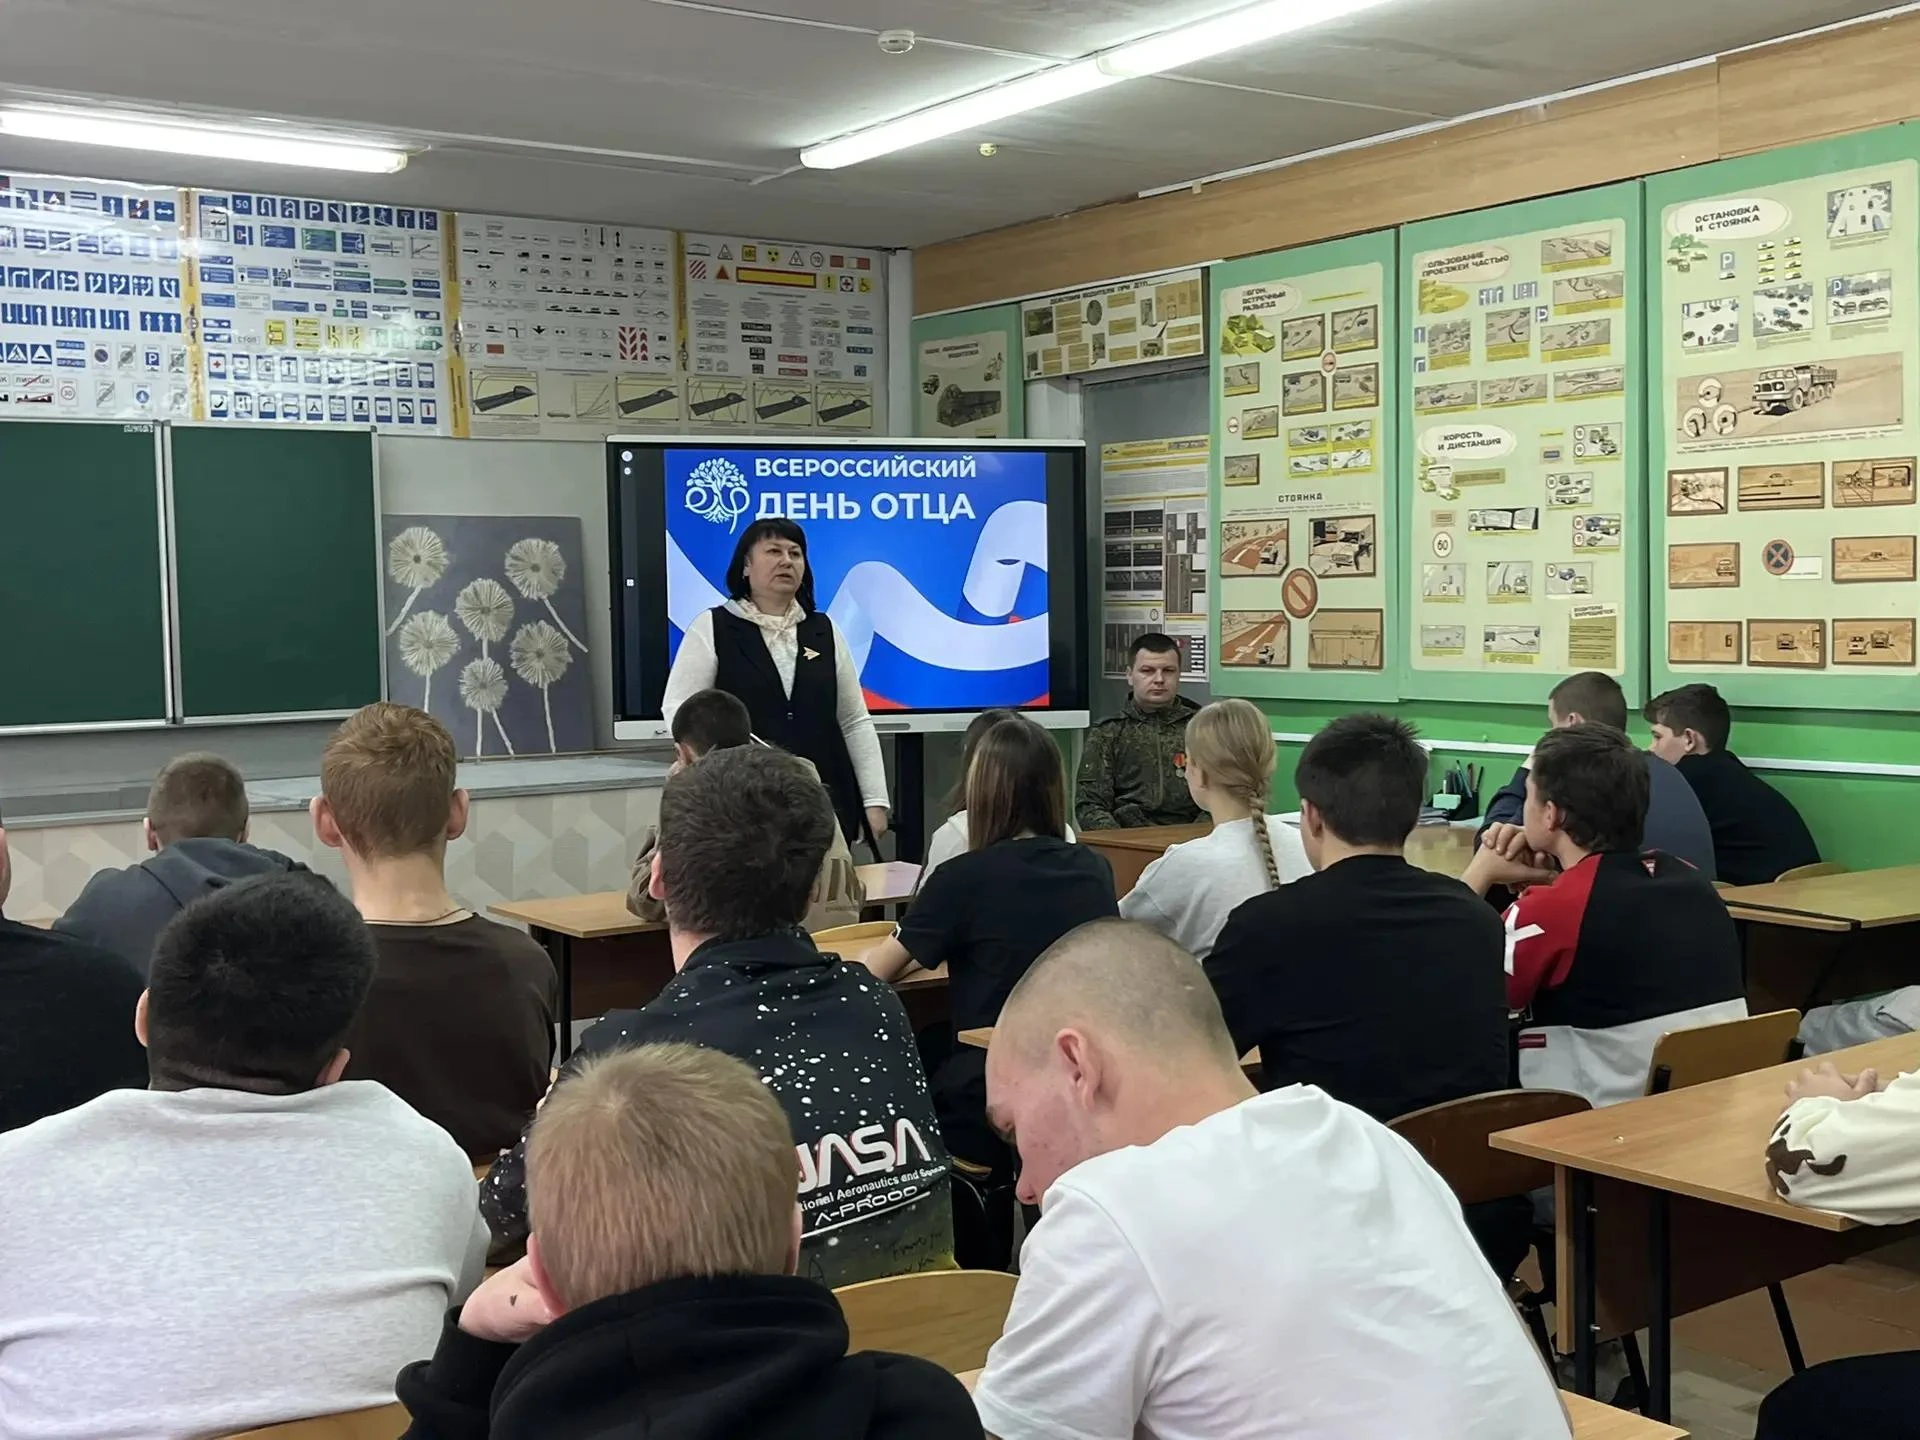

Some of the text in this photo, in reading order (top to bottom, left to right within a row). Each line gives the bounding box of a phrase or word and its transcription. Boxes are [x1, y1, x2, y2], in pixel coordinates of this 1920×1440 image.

[236, 200, 249, 209] 50
[309, 203, 320, 218] P
[1695, 205, 1760, 223] ОСТАНОВКА
[1708, 214, 1760, 230] СТОЯНКА
[1425, 251, 1484, 268] ОЛЬЗОВАНИЕ
[1472, 254, 1509, 267] ЧАСТЬЮ
[1723, 253, 1733, 270] P
[1439, 431, 1483, 441] КОРОСТЬ
[1447, 438, 1501, 450] ДИСТАНЦИЯ
[755, 455, 977, 478] ВСЕРОССИЙСКИЙ
[1278, 492, 1323, 503] СТОЯНКА
[755, 492, 976, 525] ДЕНЬ ОТЦА
[800, 1191, 834, 1213] tional
[836, 1175, 900, 1201] Aeronautics
[900, 1169, 919, 1183] and
